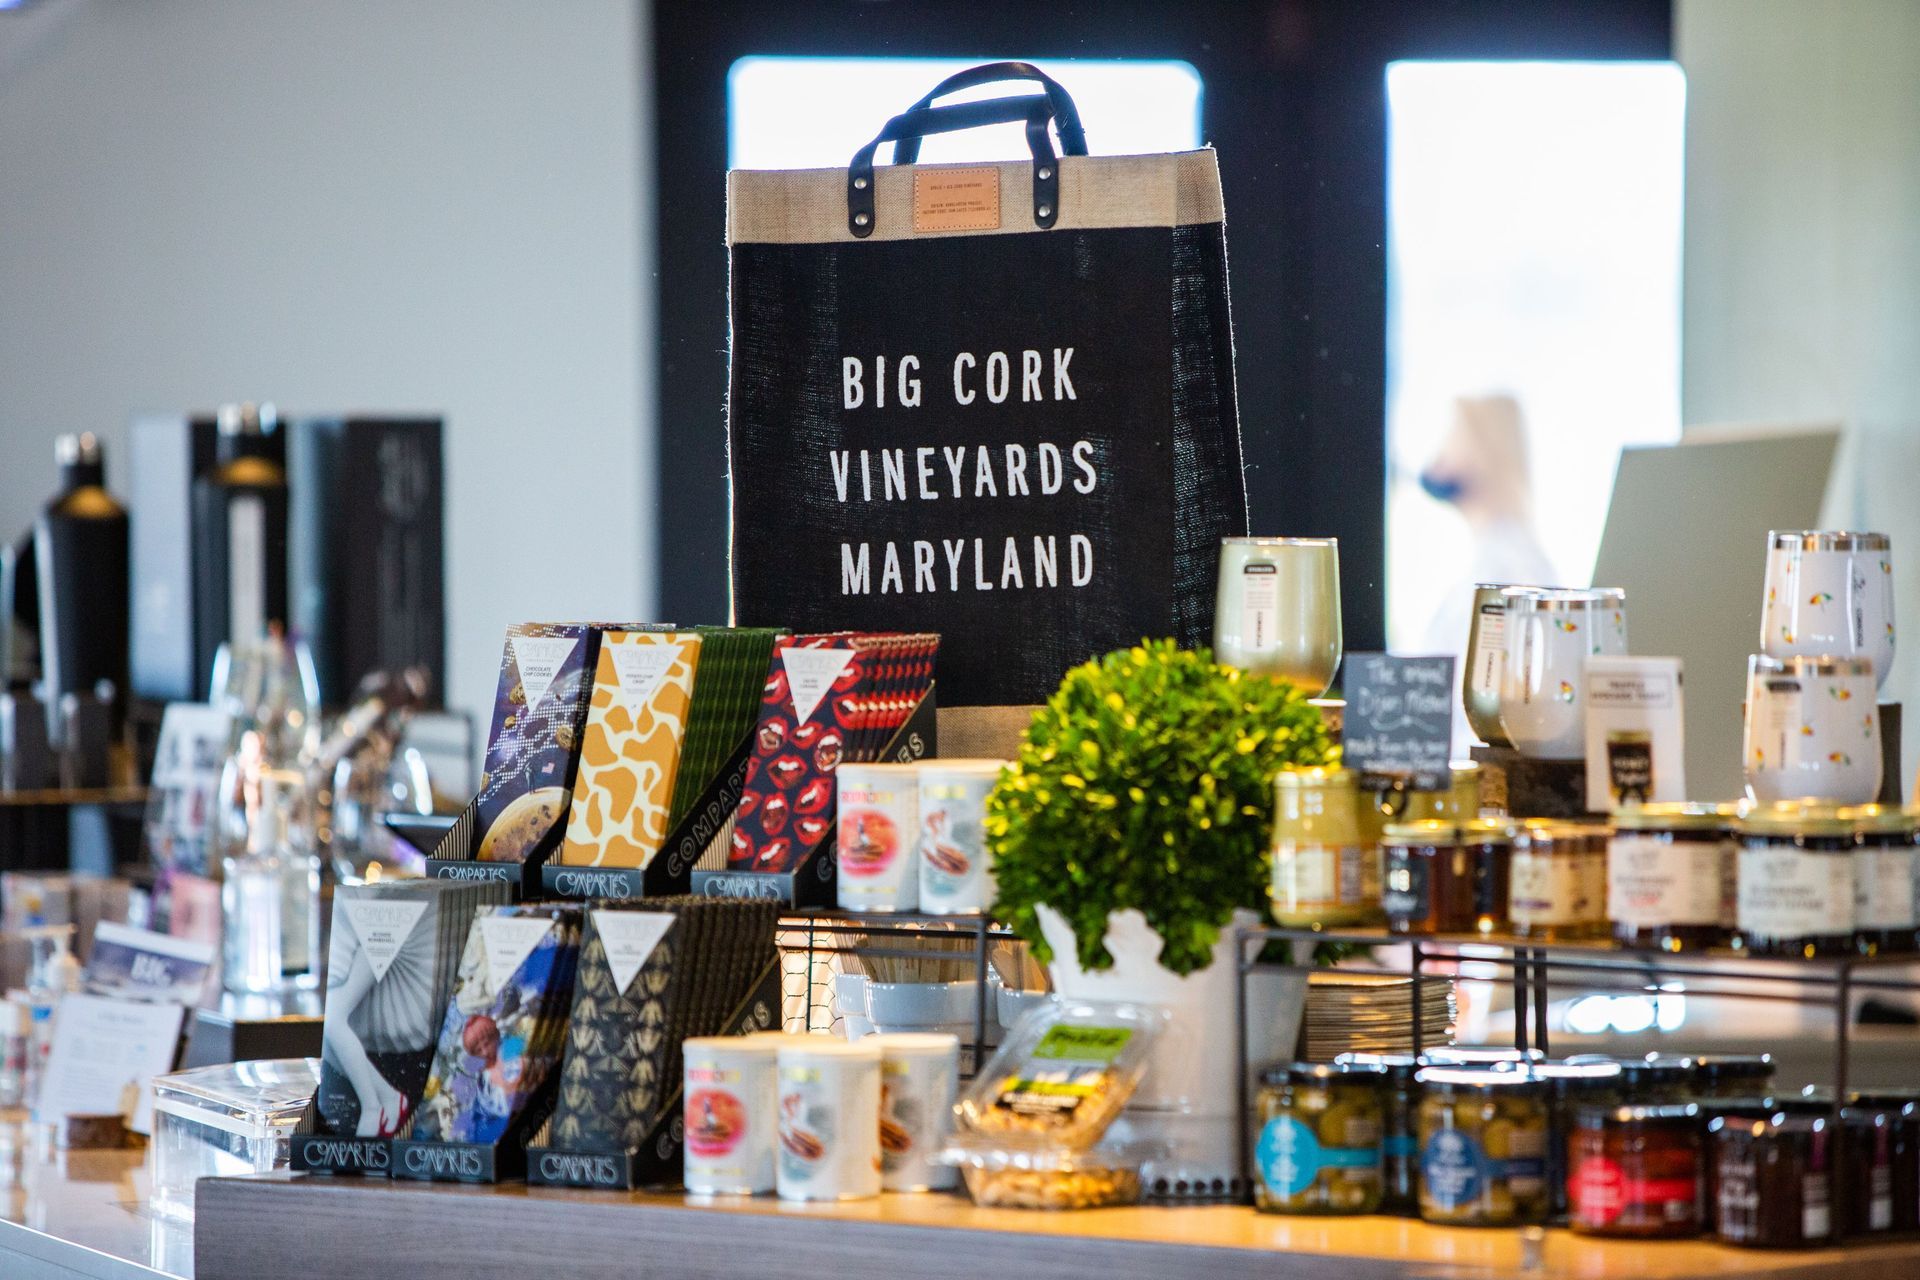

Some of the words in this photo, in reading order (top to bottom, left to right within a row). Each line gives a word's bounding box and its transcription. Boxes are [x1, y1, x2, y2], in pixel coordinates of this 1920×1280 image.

[843, 355, 922, 409] BIG
[953, 347, 1077, 405] CORK
[829, 440, 1097, 503] VINEYARDS
[841, 534, 1093, 595] MARYLAND
